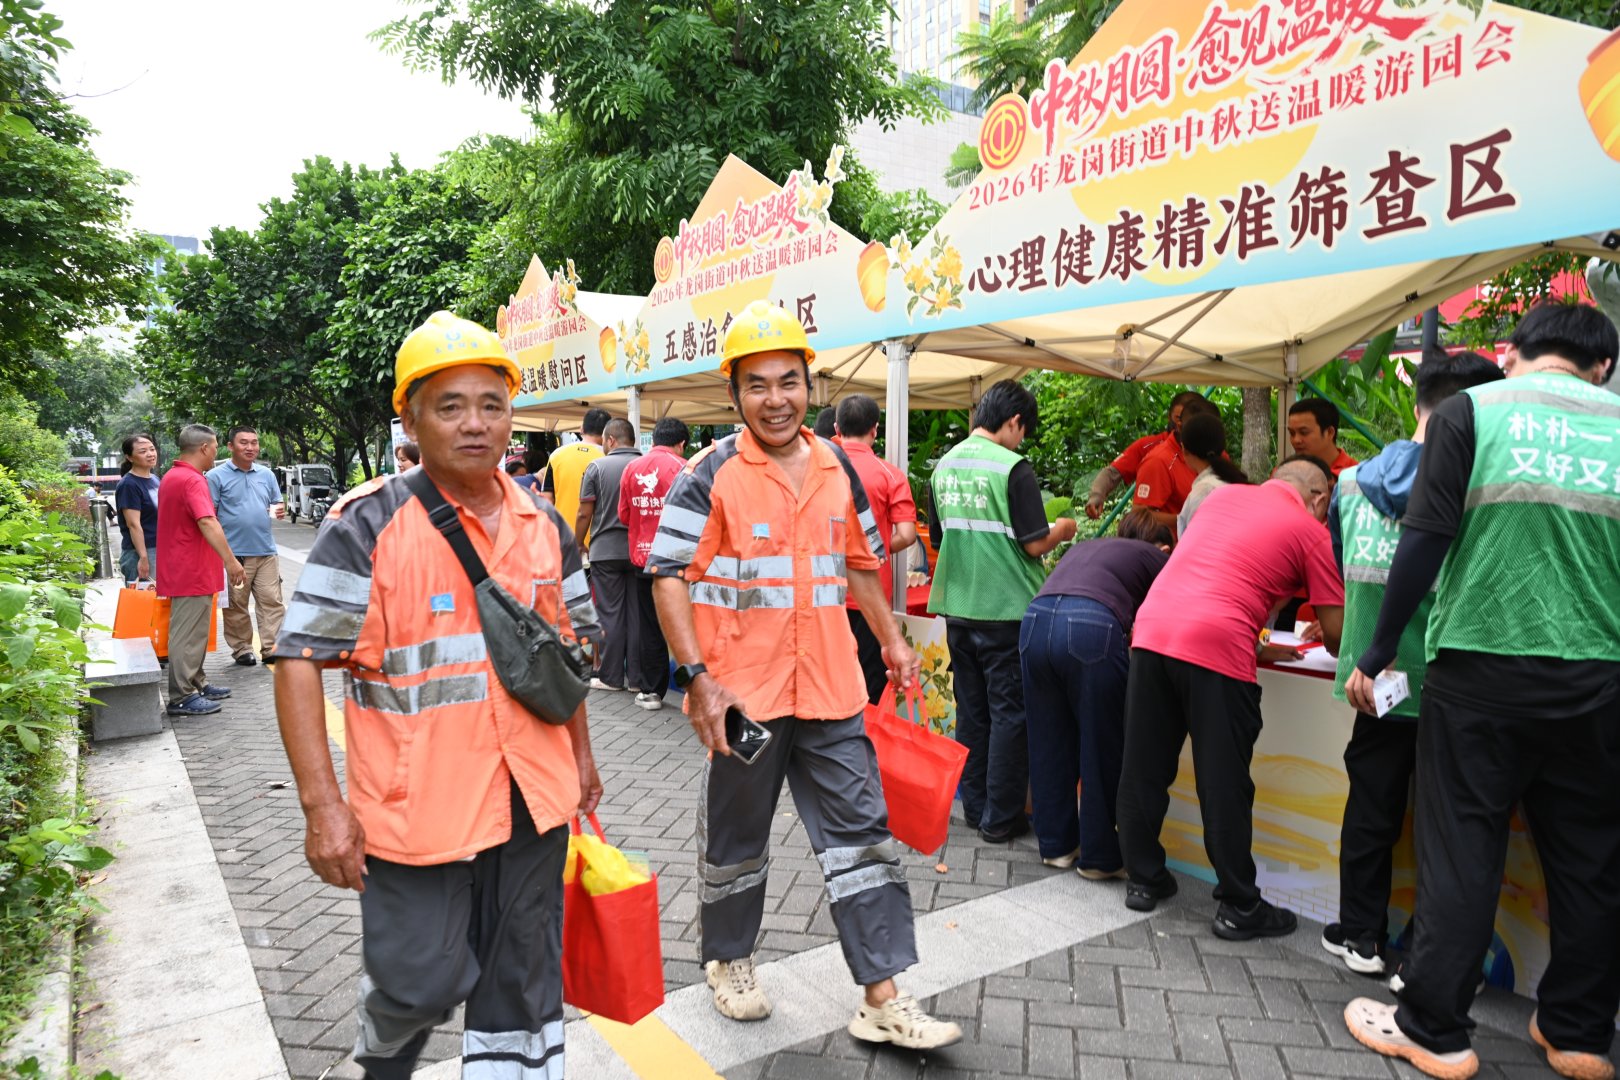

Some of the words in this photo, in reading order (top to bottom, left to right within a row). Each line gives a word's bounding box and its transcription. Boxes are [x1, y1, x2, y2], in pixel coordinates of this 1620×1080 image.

[969, 20, 1516, 210] 2026年龙岗街道中秋送温暖游园会
[651, 230, 838, 307] 2026年龙岗街道中秋送温暖游园会
[968, 128, 1516, 293] 心理健康精准筛查区
[1508, 411, 1620, 449] 朴朴一
